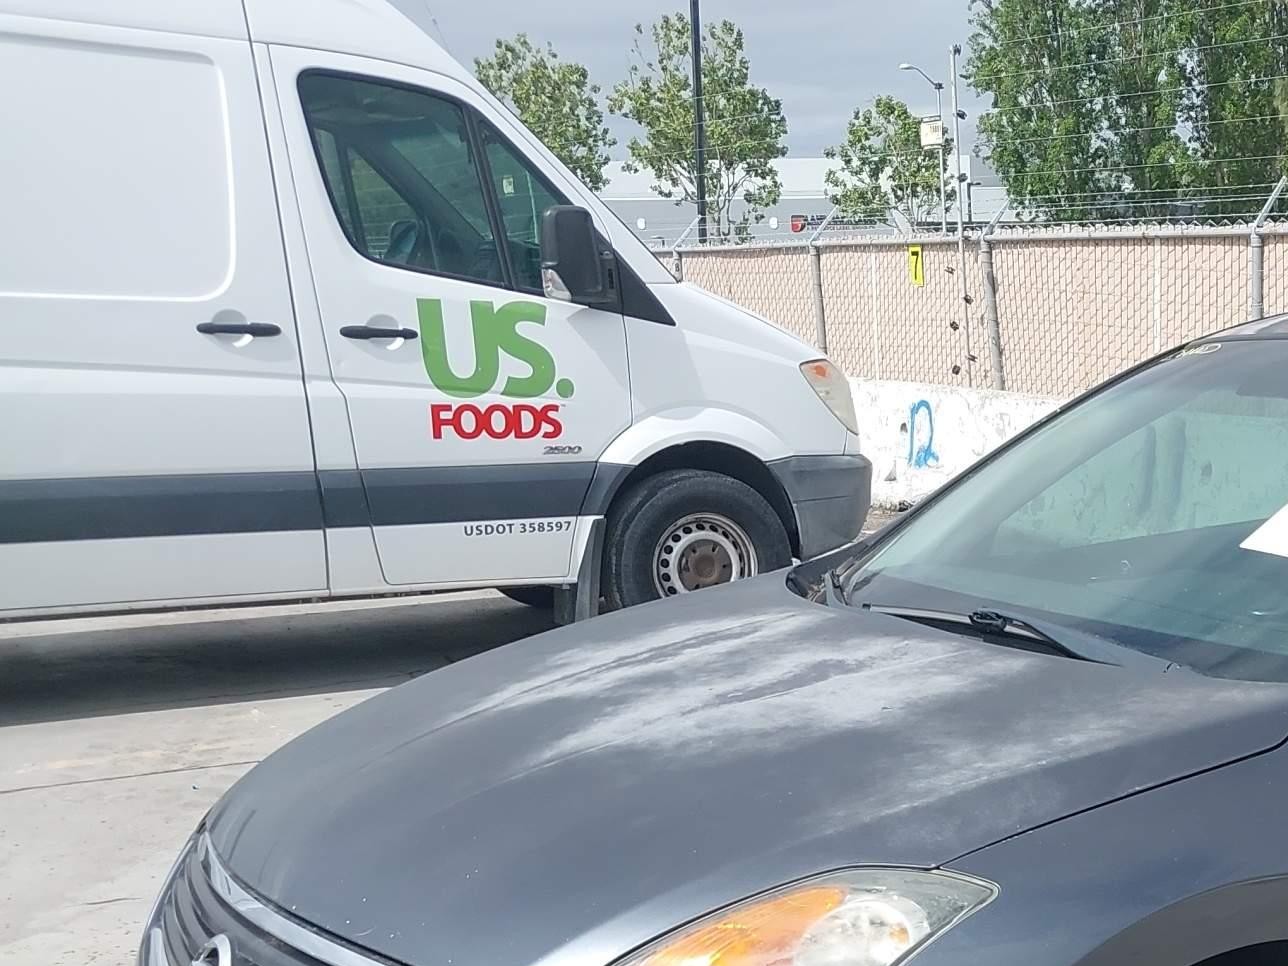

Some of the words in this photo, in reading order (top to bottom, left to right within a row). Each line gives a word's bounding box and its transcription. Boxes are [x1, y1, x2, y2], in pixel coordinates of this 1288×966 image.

[910, 250, 920, 281] 7
[542, 445, 583, 456] 2500
[463, 523, 515, 537] USDOT
[519, 520, 572, 534] 358597
